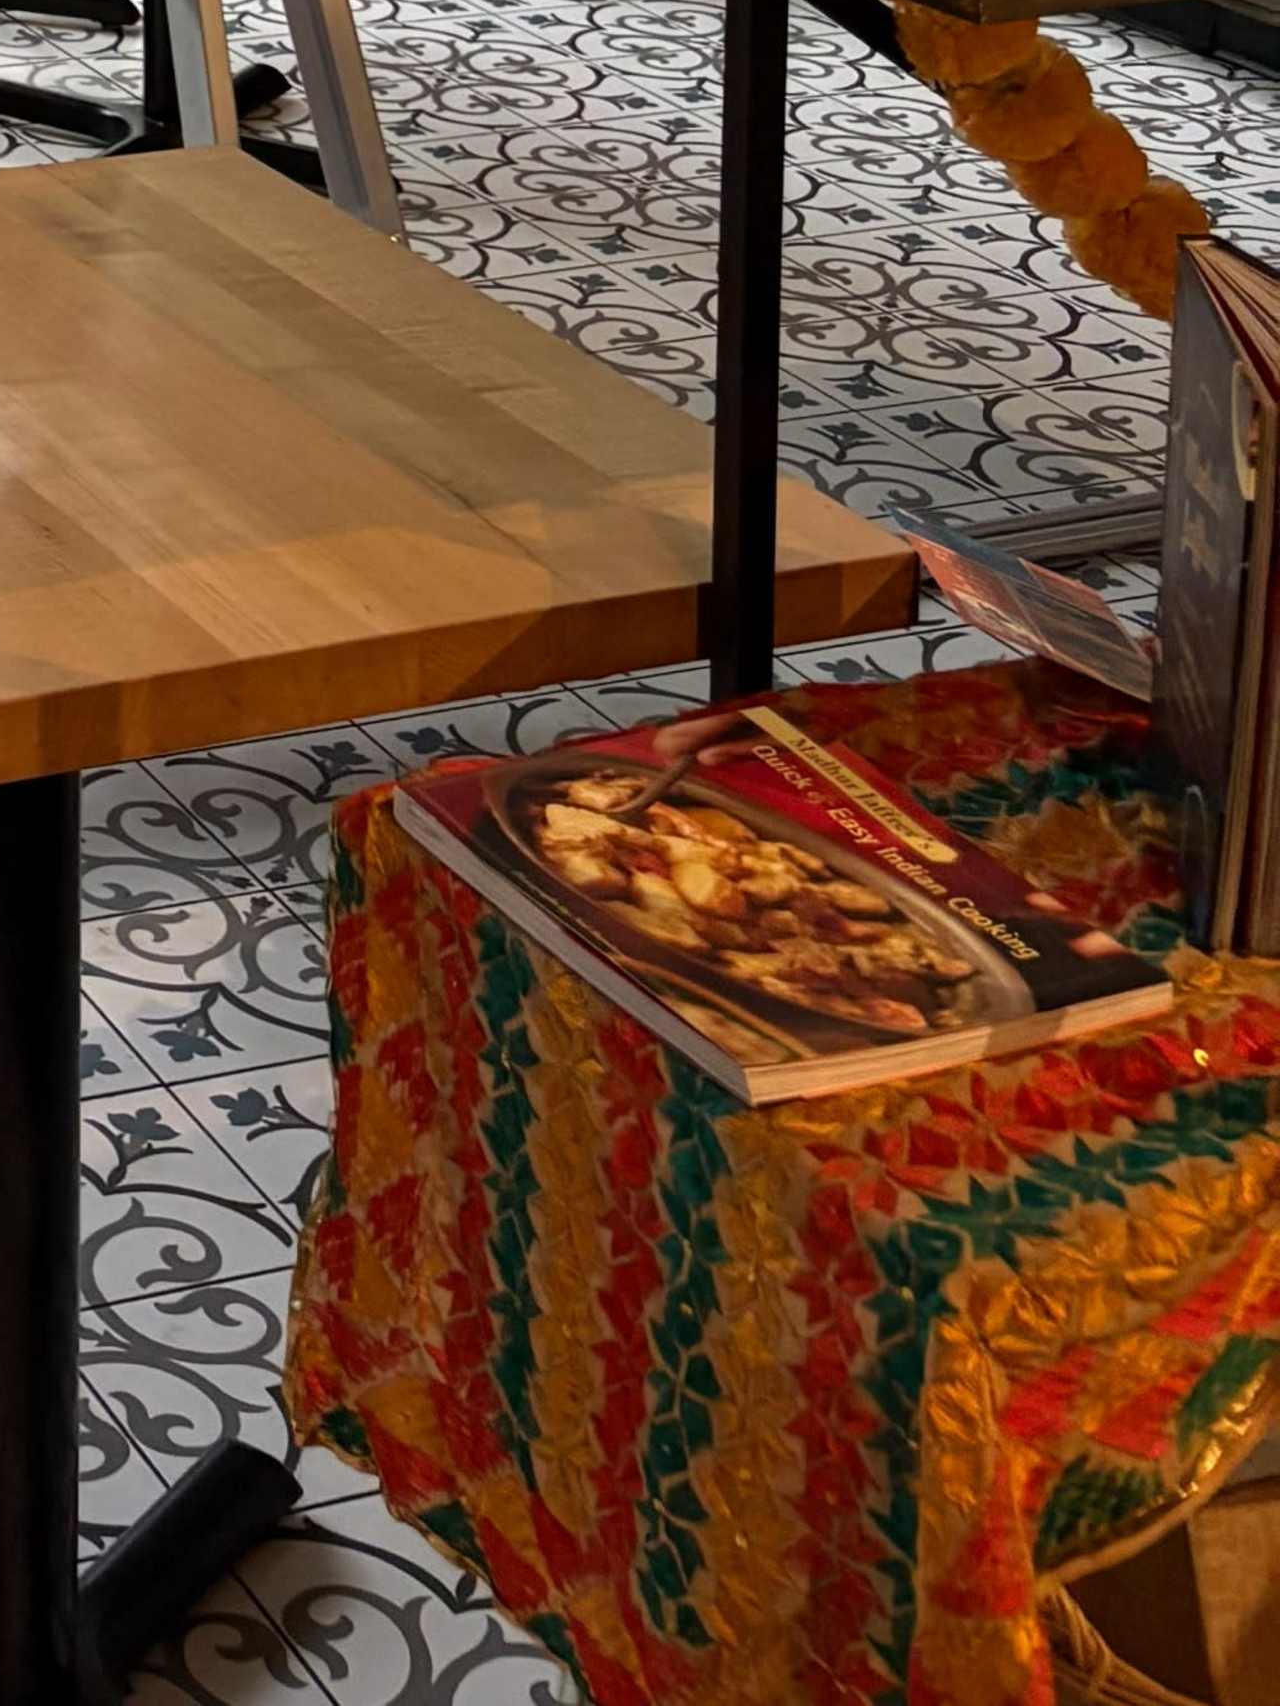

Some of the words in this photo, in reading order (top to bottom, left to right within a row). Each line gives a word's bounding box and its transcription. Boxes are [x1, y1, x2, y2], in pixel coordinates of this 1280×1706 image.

[791, 736, 864, 793] Madhur
[751, 744, 813, 791] Quick
[827, 807, 881, 845] Easy
[877, 847, 948, 897] Indian
[948, 896, 1040, 961] Cooking
